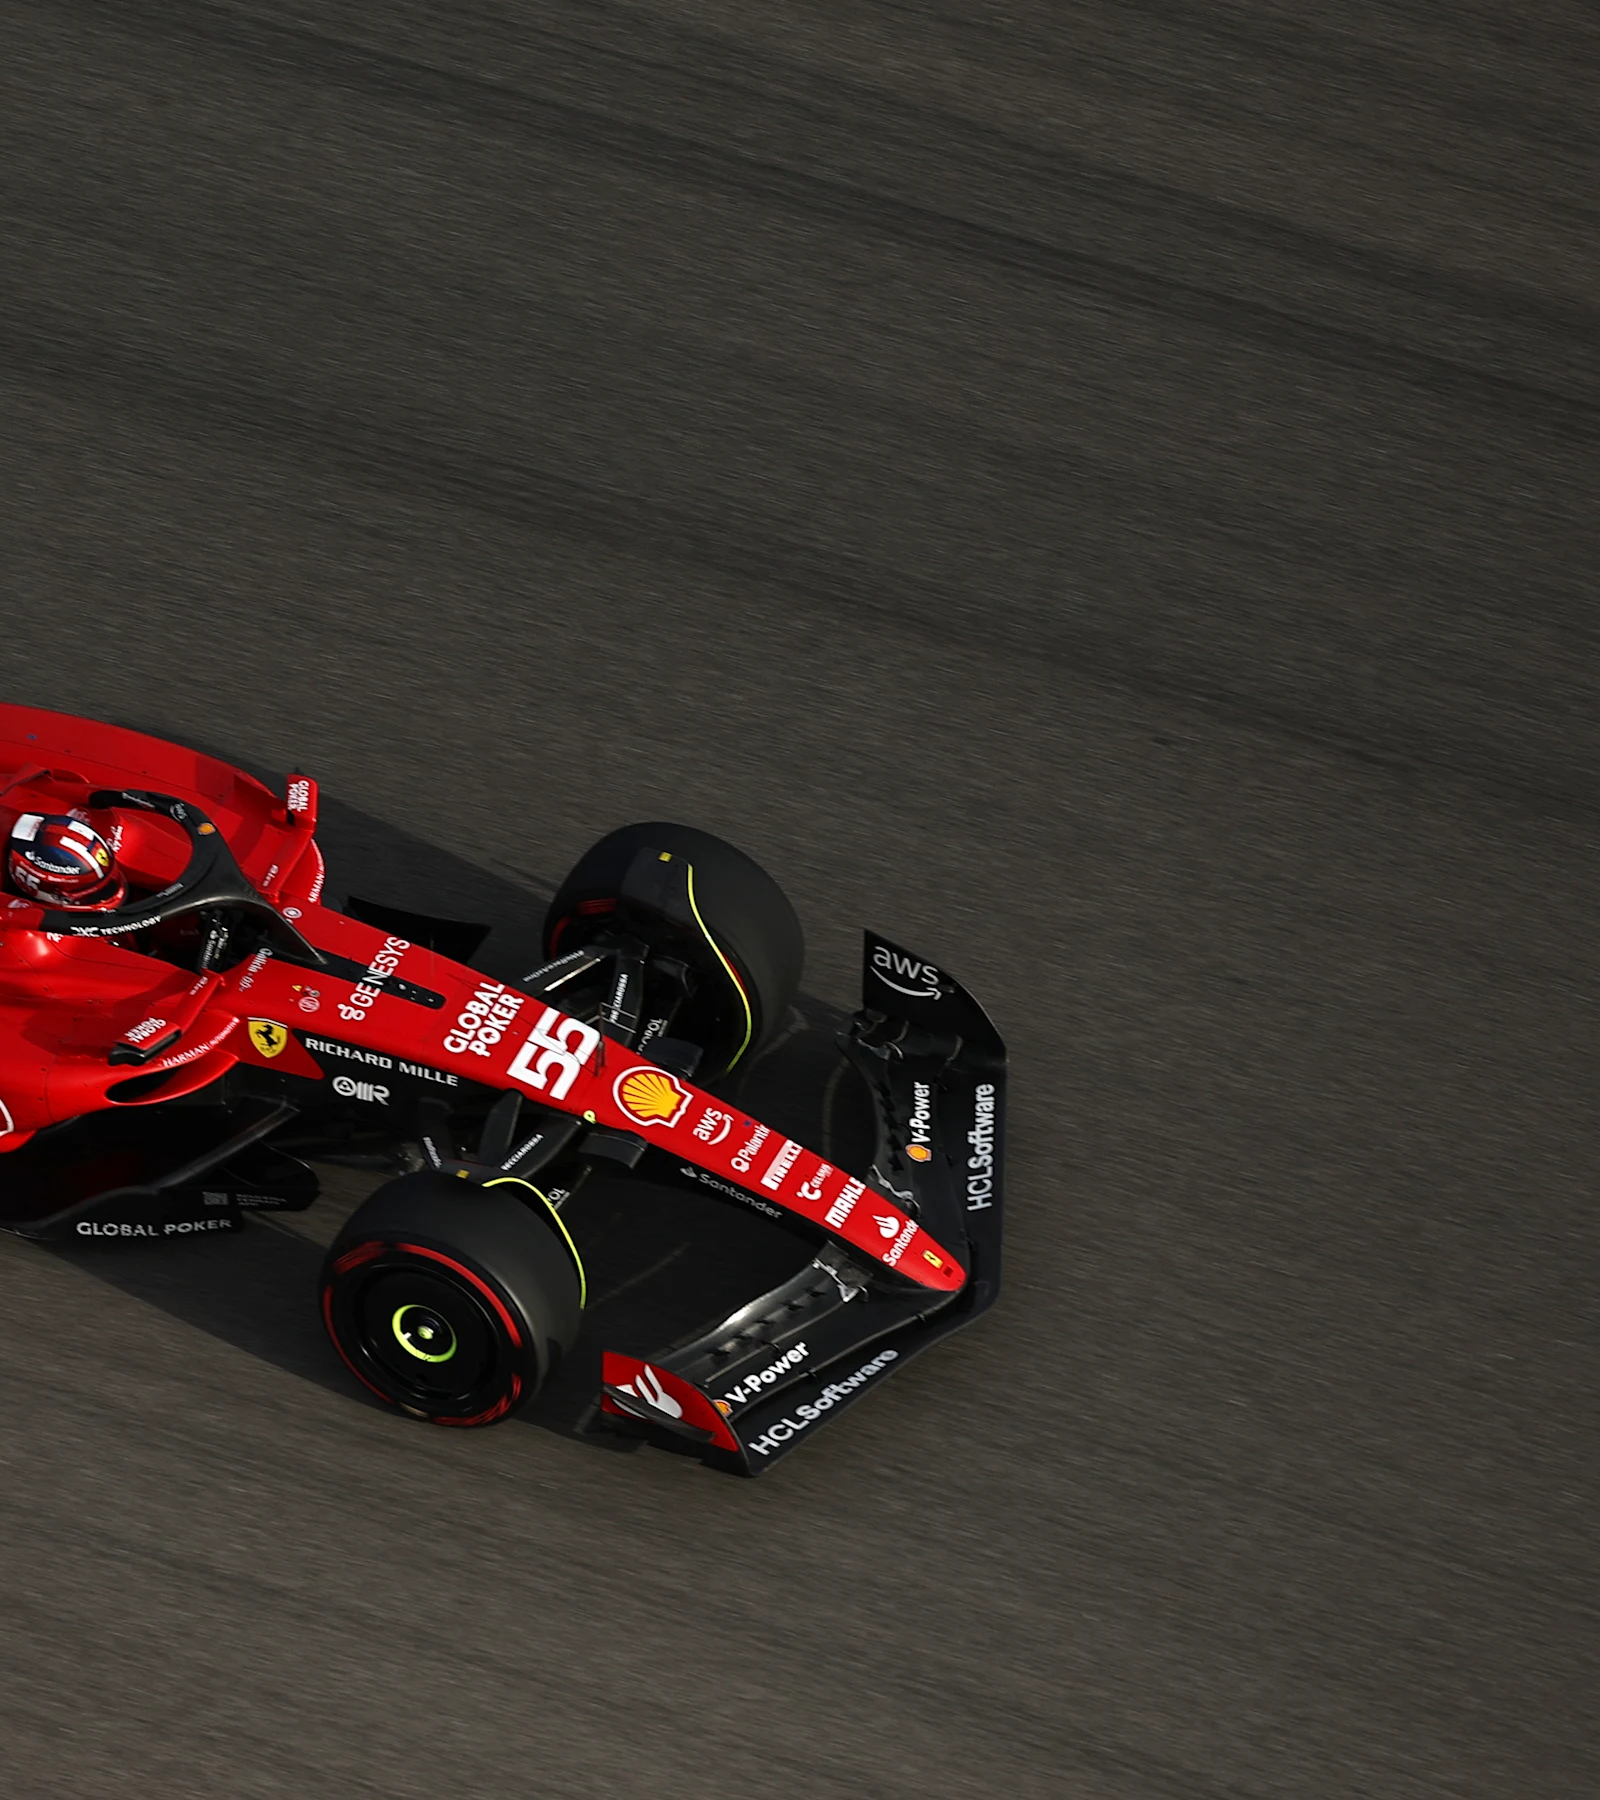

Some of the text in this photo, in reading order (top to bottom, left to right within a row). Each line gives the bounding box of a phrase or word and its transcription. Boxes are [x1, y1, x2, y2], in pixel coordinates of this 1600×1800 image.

[100, 915, 162, 937] TECHNOLOGY
[350, 936, 411, 1008] GENESYS
[872, 945, 940, 986] aws
[443, 982, 506, 1053] GLOBAL
[468, 994, 525, 1058] POKER
[162, 1042, 210, 1067] HARMAN
[305, 1037, 458, 1087] RICHARD MILLE
[506, 1006, 602, 1101] 55
[692, 1107, 723, 1141] aws
[909, 1081, 931, 1143] V-Power
[742, 1133, 771, 1172] Palantir
[760, 1138, 804, 1191] PIRELLI
[966, 1083, 996, 1212] HCLSoftware
[699, 1173, 783, 1219] Santander
[76, 1219, 232, 1237] GLOBAL POKER
[725, 1341, 810, 1406] V-Power
[748, 1349, 900, 1456] HCLSoftware
